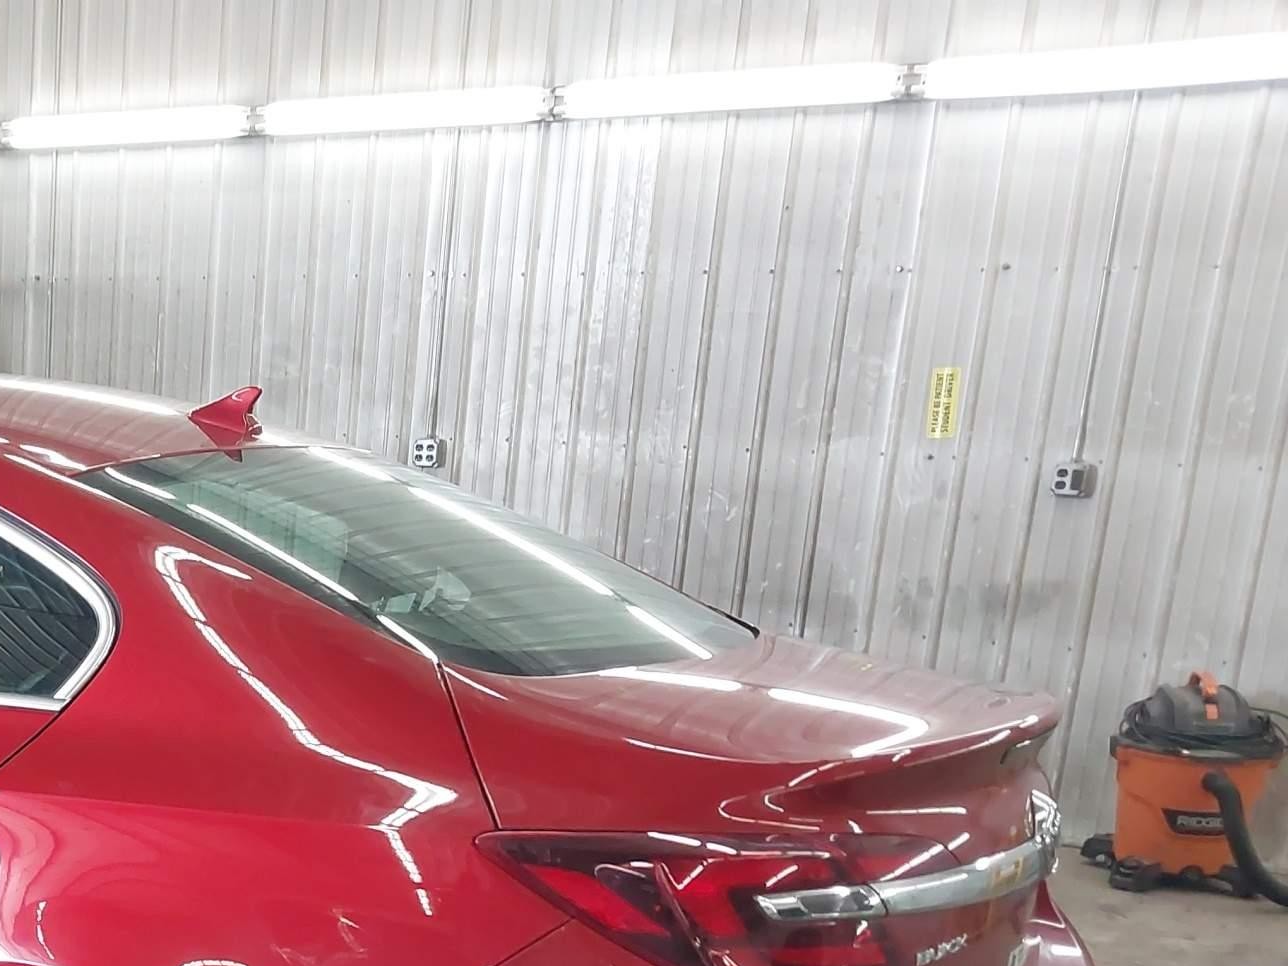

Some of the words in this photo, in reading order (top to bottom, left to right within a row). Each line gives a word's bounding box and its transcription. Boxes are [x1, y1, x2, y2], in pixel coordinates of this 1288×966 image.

[934, 373, 944, 400] PATIENT
[943, 373, 954, 399] DRIVER
[930, 410, 940, 433] PLEASE
[940, 402, 951, 433] STUDENT
